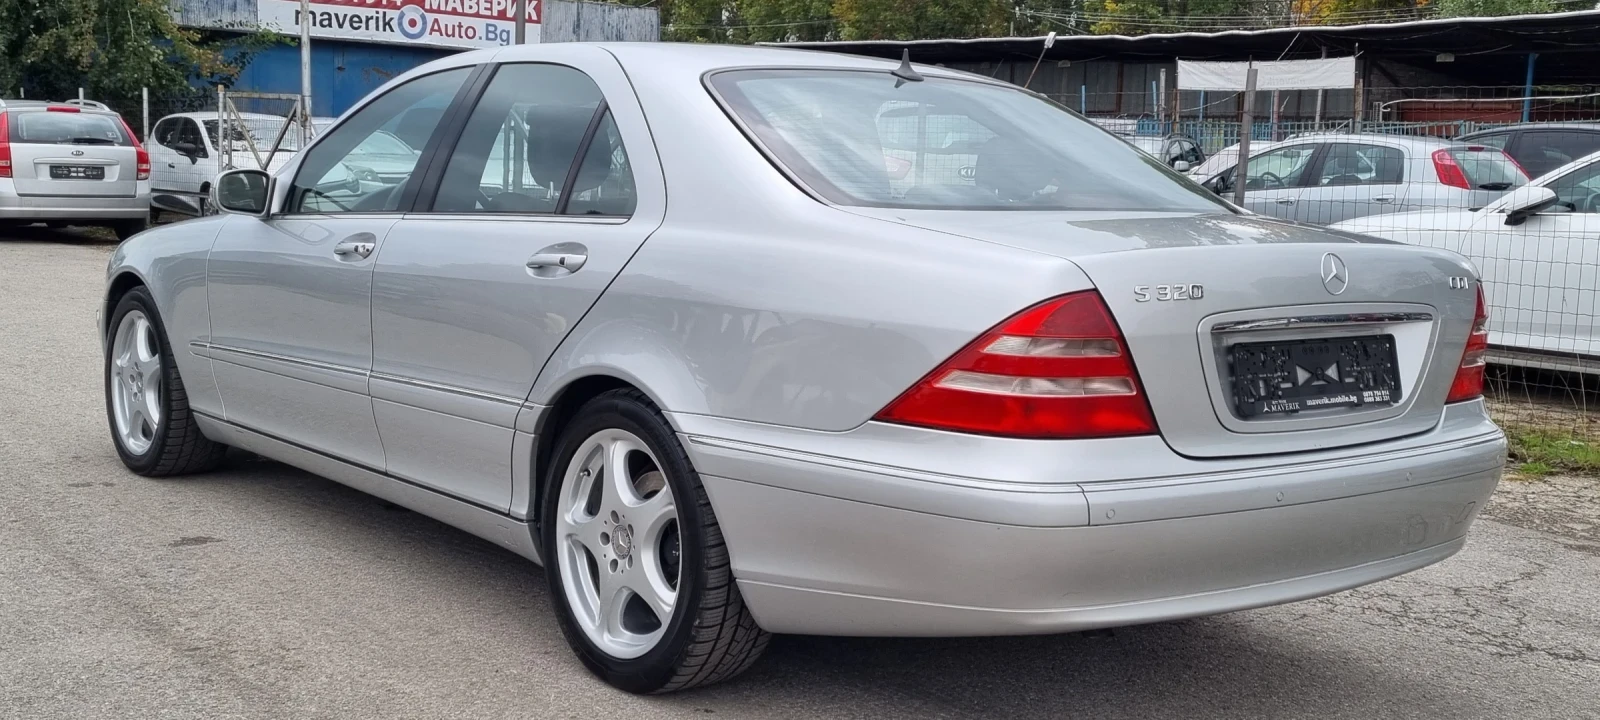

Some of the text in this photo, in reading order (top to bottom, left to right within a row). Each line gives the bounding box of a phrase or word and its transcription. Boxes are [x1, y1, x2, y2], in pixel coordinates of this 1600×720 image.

[295, 9, 511, 46] maverik Auto.Bg
[1134, 283, 1204, 302] S 320
[1271, 402, 1300, 412] MAVERIK
[1306, 395, 1358, 406] maverik.mobile.bg
